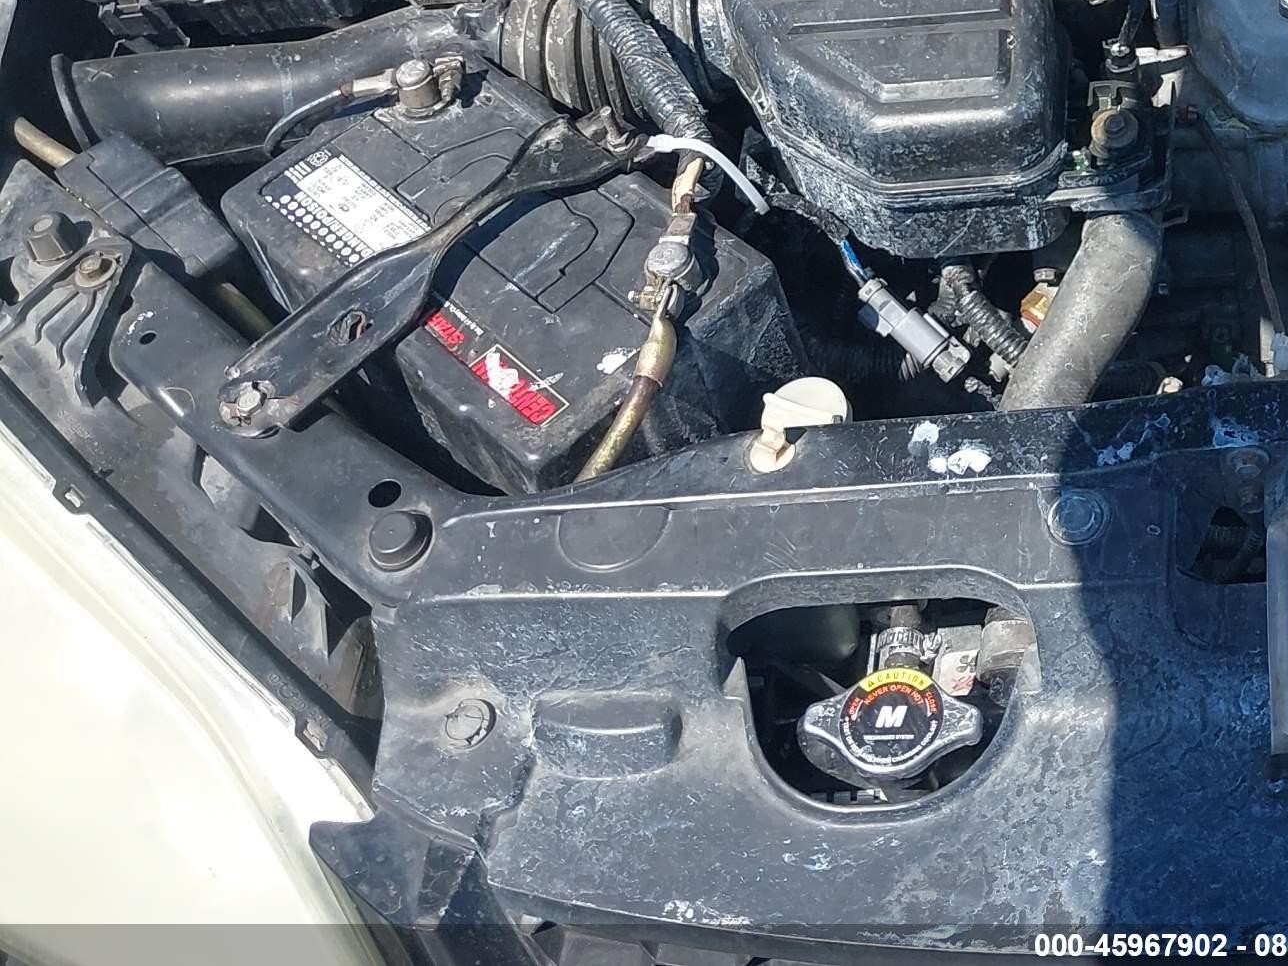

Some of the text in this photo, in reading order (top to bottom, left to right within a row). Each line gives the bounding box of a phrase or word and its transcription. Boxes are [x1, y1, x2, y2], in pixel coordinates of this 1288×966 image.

[294, 191, 374, 259] DANGER/POISON
[876, 672, 926, 686] CAUTION
[849, 697, 860, 715] OPEN
[863, 684, 925, 706] NEVER OPEN HOT
[925, 691, 938, 714] CLOSE
[875, 705, 908, 729] M
